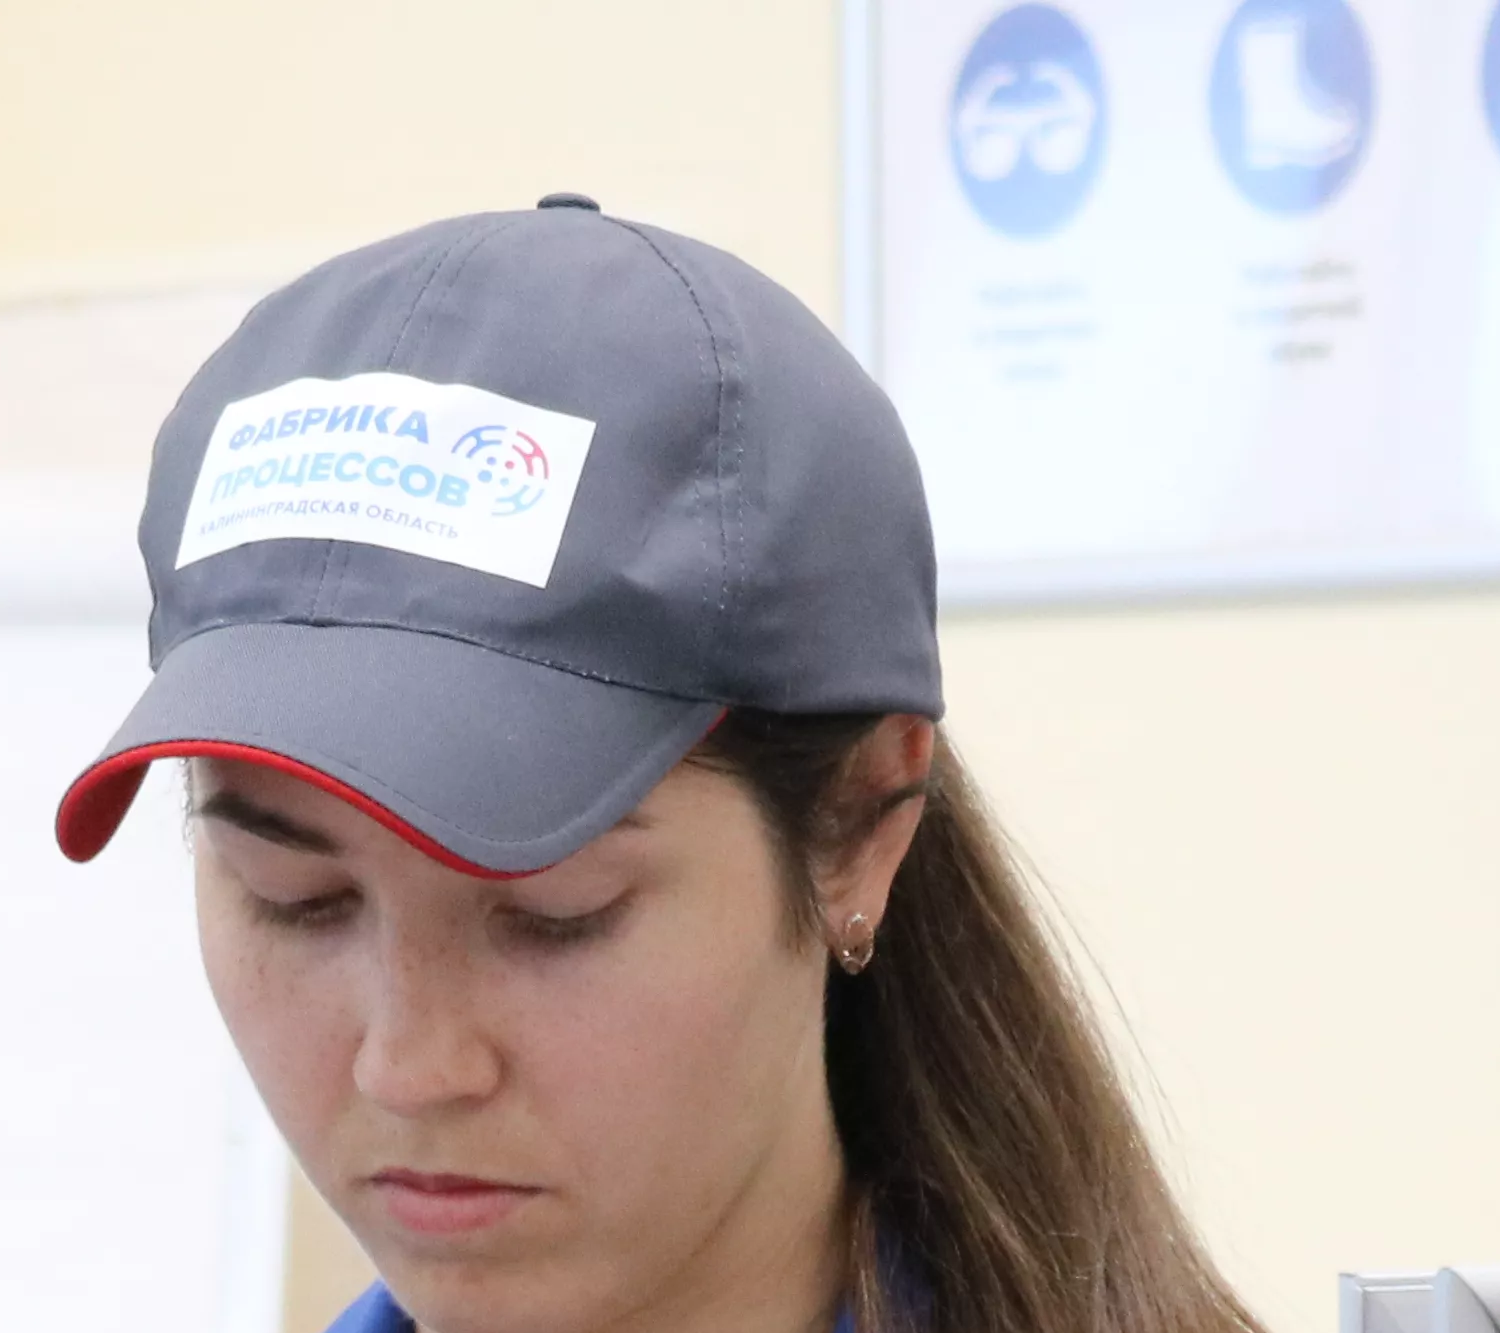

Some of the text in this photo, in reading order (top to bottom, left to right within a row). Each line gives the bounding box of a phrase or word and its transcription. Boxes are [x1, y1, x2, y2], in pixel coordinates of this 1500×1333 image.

[227, 403, 430, 451] ФАБРИКА
[209, 450, 471, 508] ПРОЦЕССОВ
[365, 503, 459, 540] ОБЛАСТЬ
